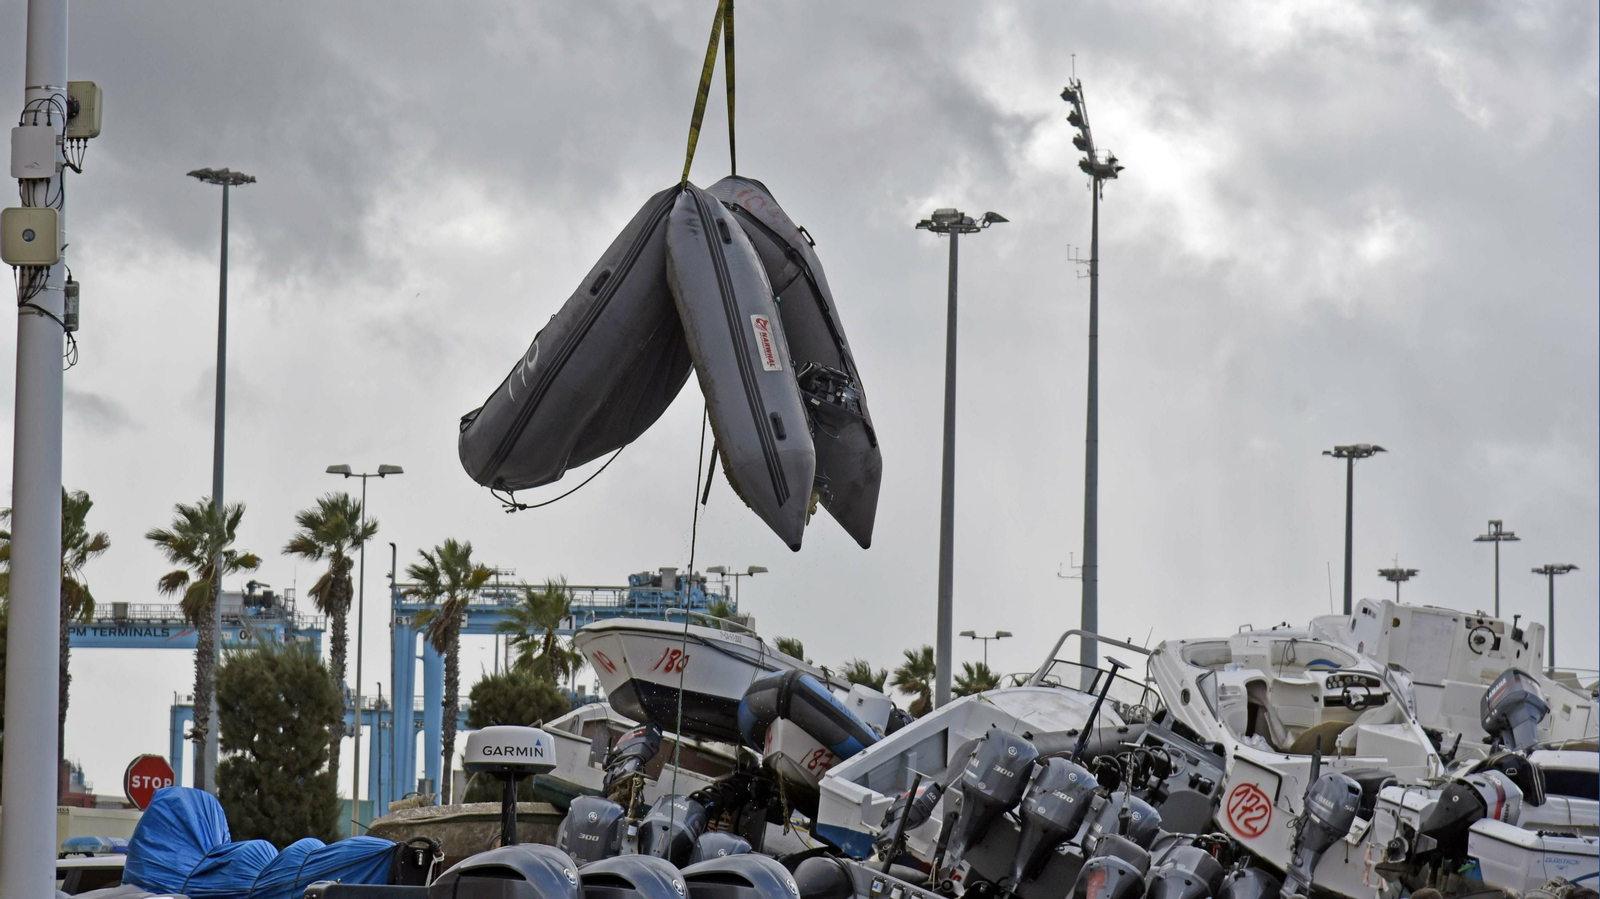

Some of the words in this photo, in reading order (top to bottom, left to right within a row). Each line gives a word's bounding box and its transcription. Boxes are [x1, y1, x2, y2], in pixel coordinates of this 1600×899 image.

[762, 332, 776, 367] NARWHAL
[90, 627, 170, 638] TERMINALS
[651, 646, 691, 674] 180
[482, 745, 544, 758] GARMIN
[800, 748, 835, 778] 187
[992, 764, 1015, 778] 300
[131, 775, 173, 790] STOP
[1230, 787, 1269, 834] 172
[578, 832, 600, 842] 300
